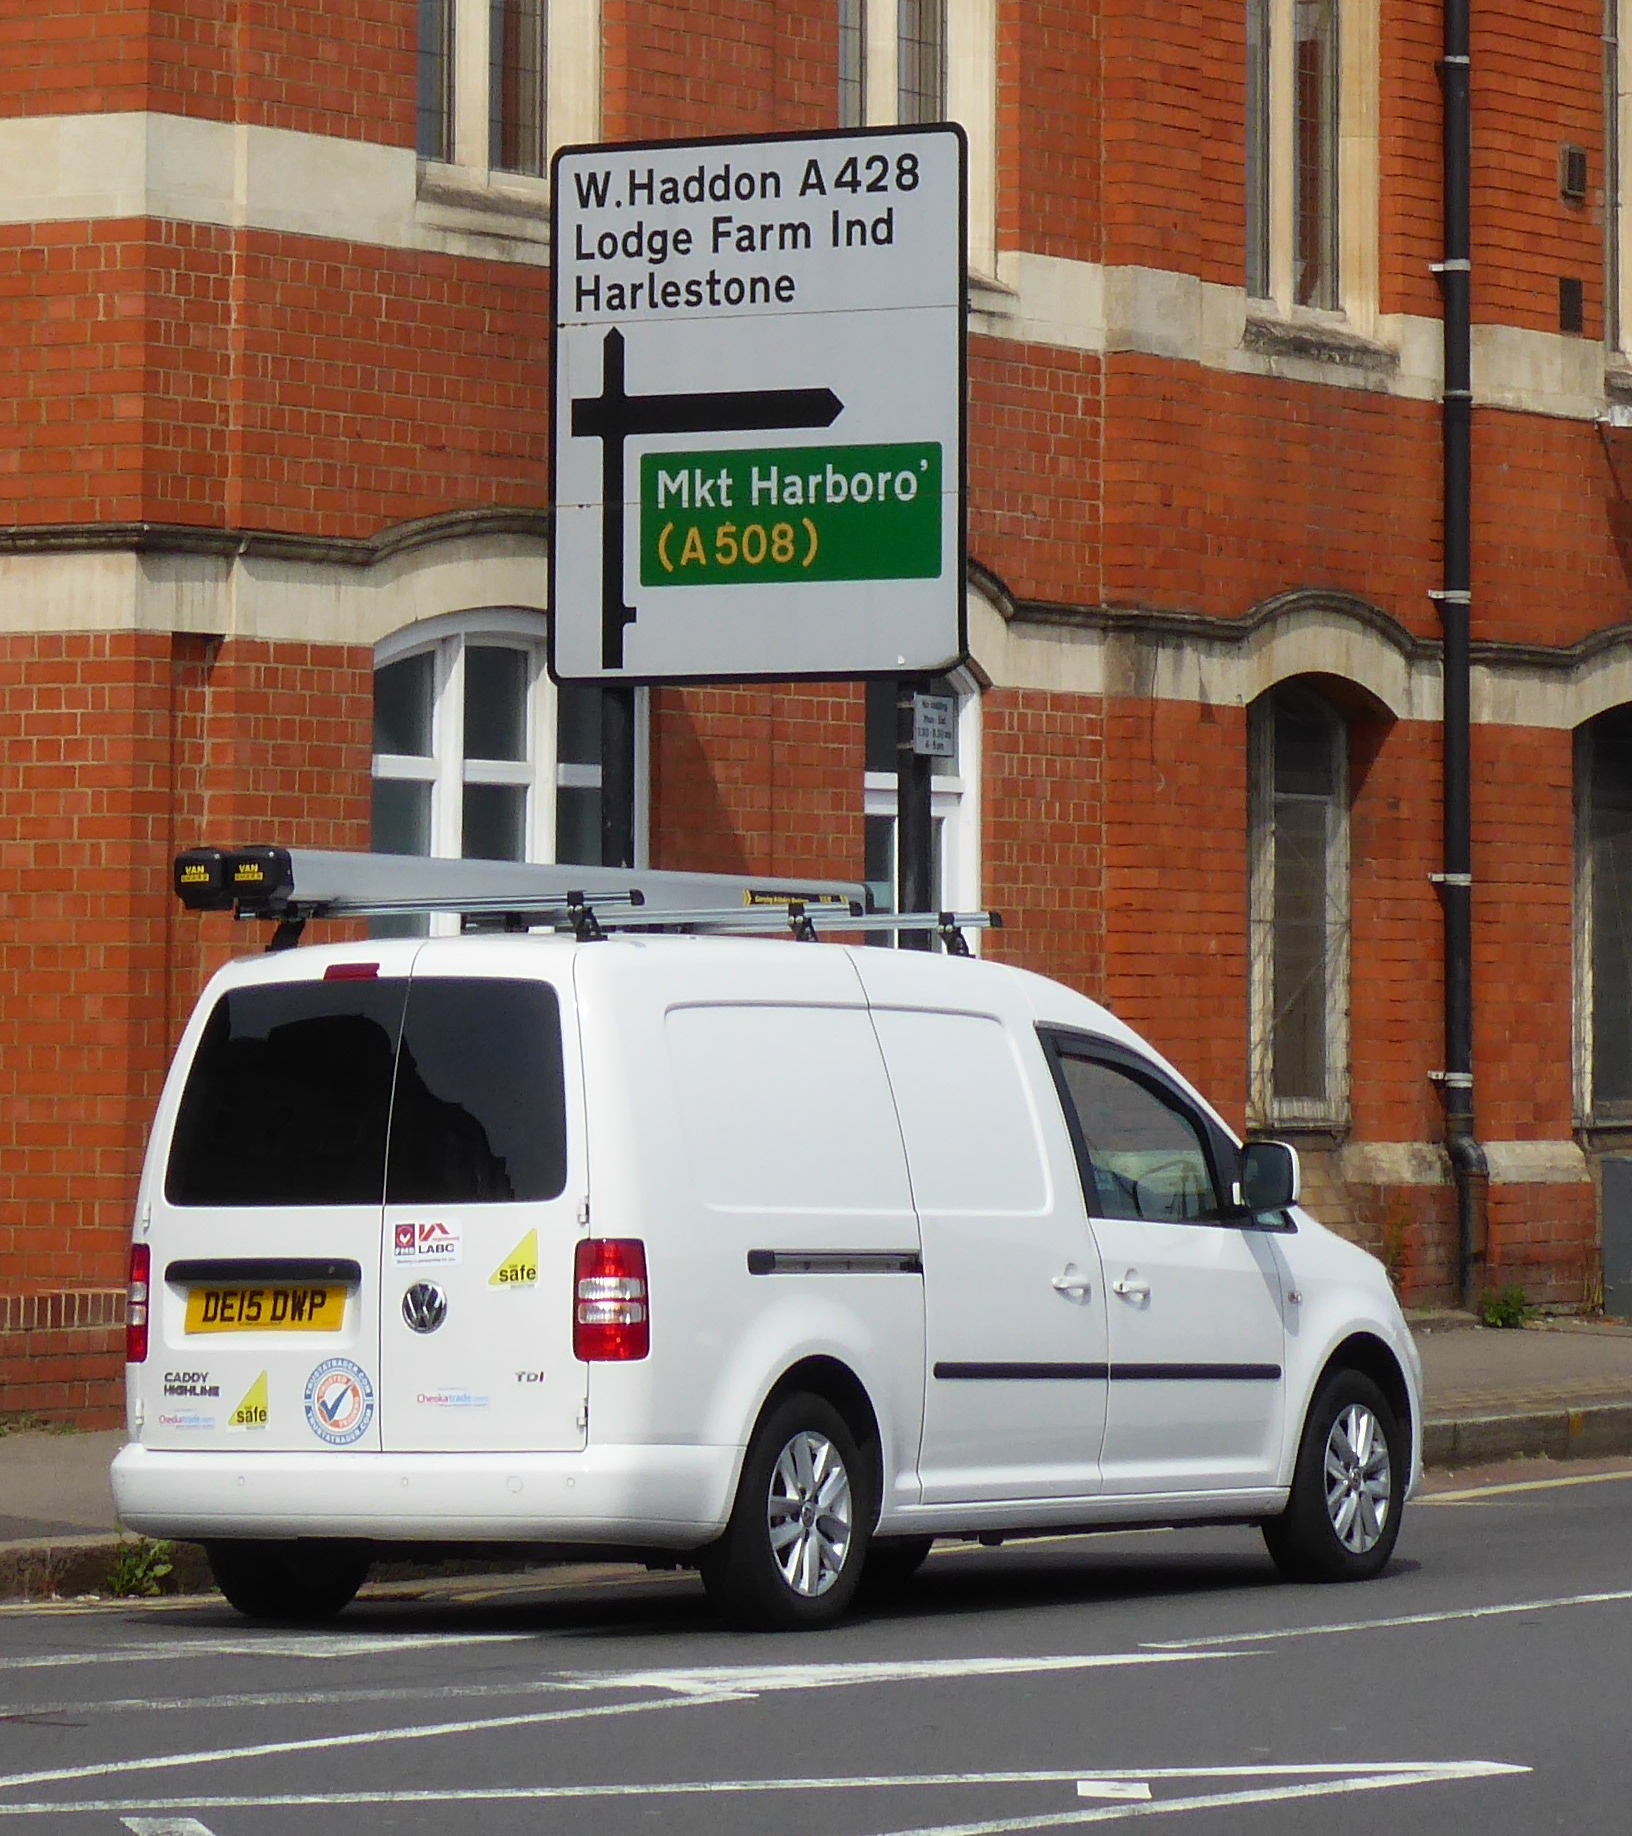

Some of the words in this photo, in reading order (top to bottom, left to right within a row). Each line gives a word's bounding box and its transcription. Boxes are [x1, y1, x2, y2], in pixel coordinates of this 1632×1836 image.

[574, 165, 782, 208] W.Haddon
[799, 152, 920, 196] A428
[574, 220, 693, 265] Lodge
[711, 215, 812, 254] Farm
[831, 207, 895, 247] Ind
[574, 269, 796, 312] Harlestone
[657, 466, 734, 509] Mkt
[751, 459, 930, 507] Harboro'
[658, 517, 819, 573] (A508)
[185, 865, 205, 875] VAN
[238, 863, 259, 873] VAN
[499, 1264, 536, 1282] safe
[202, 1290, 264, 1322] DE15
[270, 1289, 327, 1322] DWP
[164, 1372, 209, 1383] CADDY
[515, 1371, 544, 1382] TDI
[164, 1385, 220, 1397] HIGHLINE
[236, 1406, 267, 1423] safe
